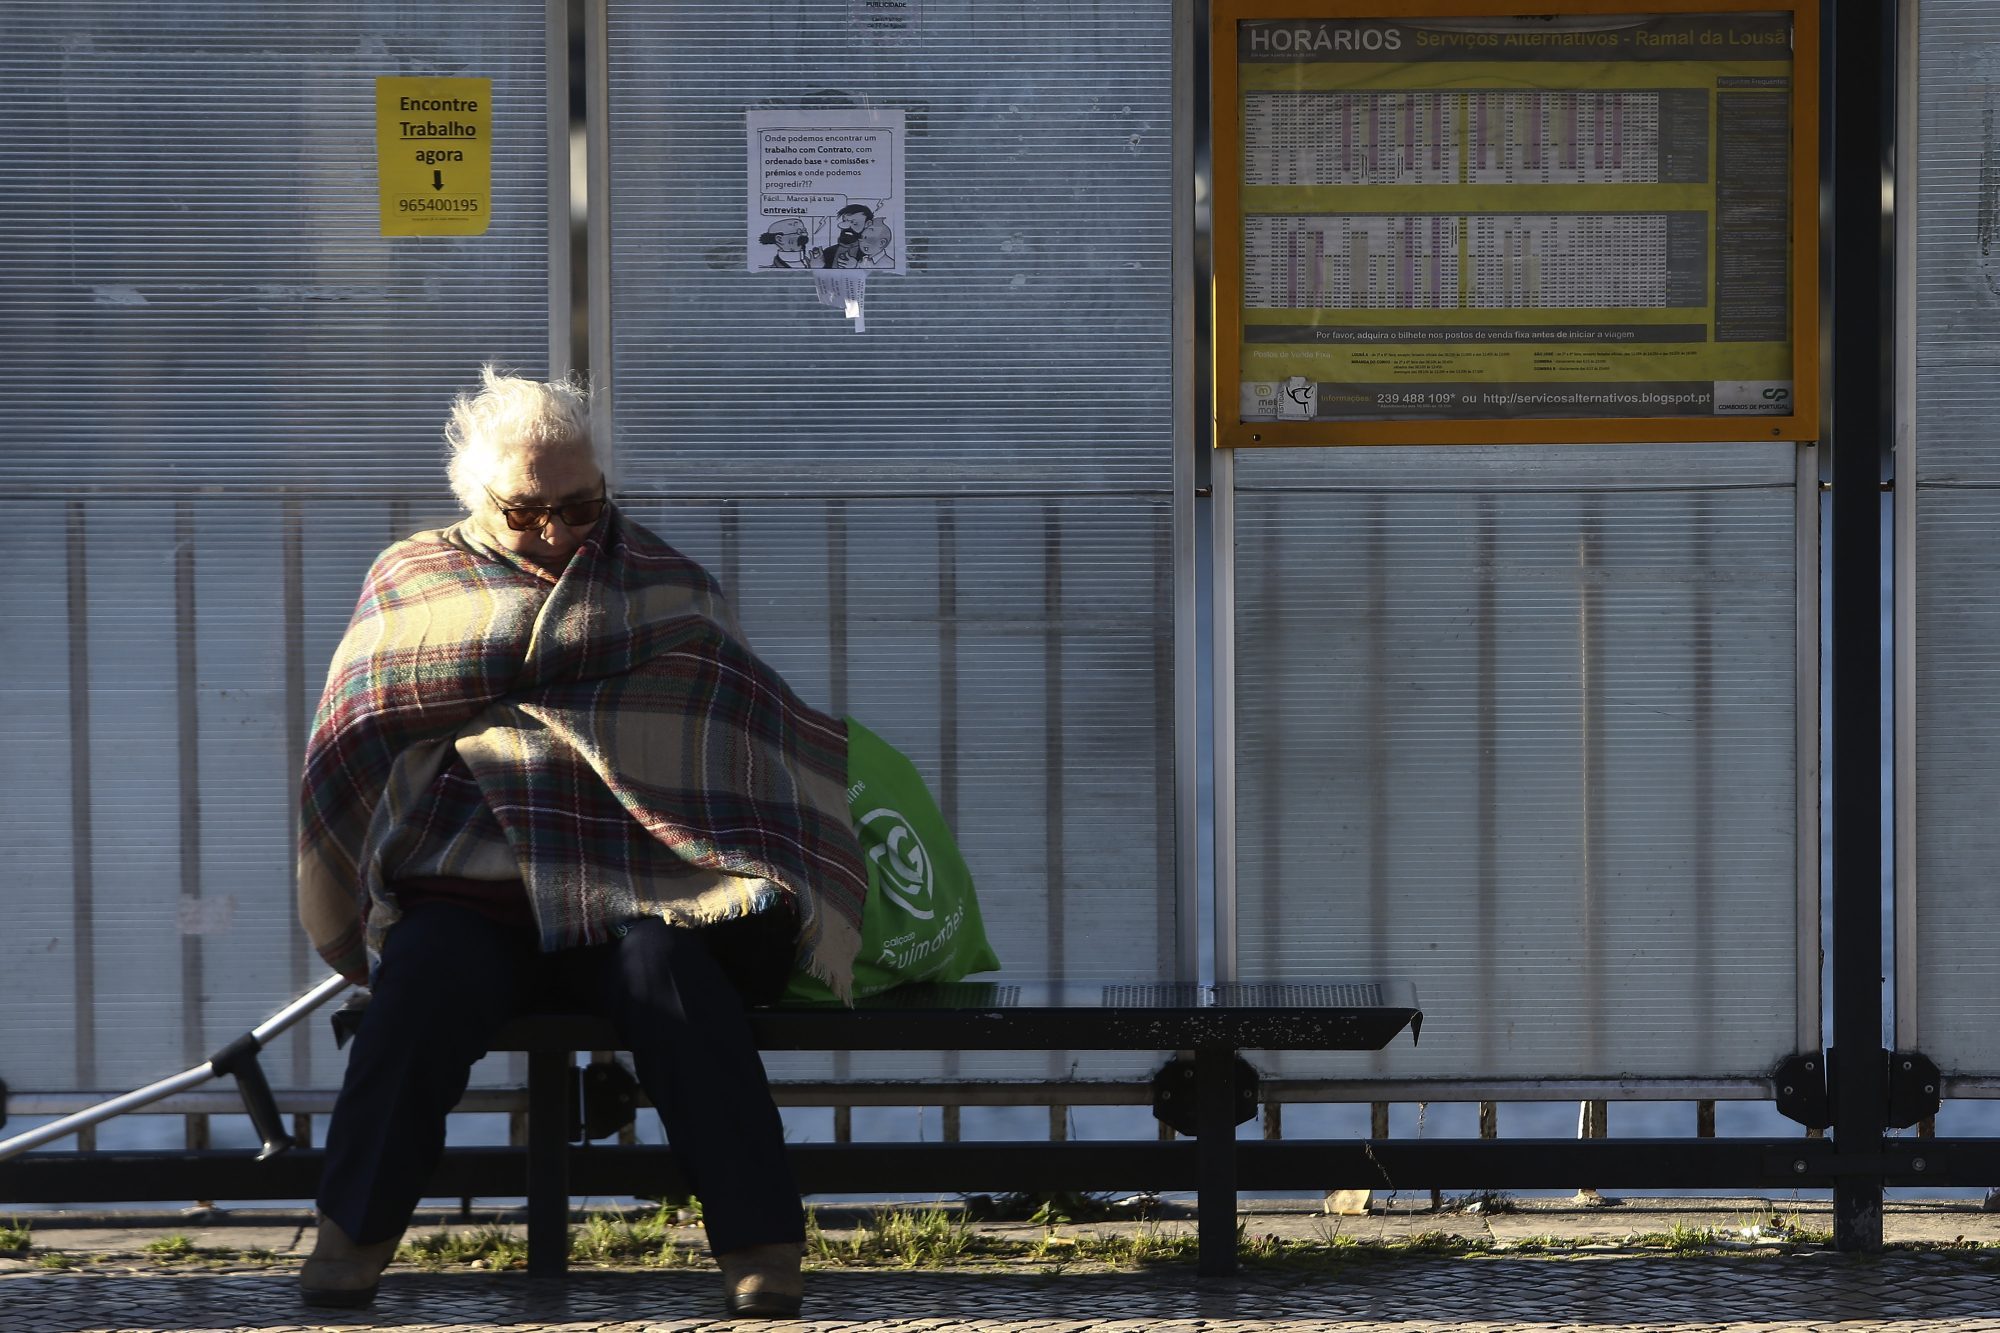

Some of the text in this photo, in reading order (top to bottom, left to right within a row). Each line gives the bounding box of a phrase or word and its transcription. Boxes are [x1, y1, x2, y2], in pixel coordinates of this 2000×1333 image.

[1250, 24, 1402, 51] HORÁRIOS
[1416, 31, 1499, 49] Serviços
[1503, 31, 1619, 47] Alternativos
[1635, 29, 1694, 47] Ramal
[1699, 29, 1723, 46] da
[1728, 29, 1786, 46] Lousã
[400, 96, 478, 112] Encontre
[400, 121, 477, 137] Trabalho
[764, 134, 787, 142] Onde
[788, 134, 824, 144] podemos
[825, 134, 863, 142] encontrar
[764, 146, 798, 154] trabalho
[817, 145, 854, 155] Contrato,
[415, 149, 464, 165] agora
[830, 157, 869, 165] comissões
[764, 169, 797, 178] prémios
[804, 169, 825, 177] onde
[825, 168, 861, 178] podemos
[765, 180, 813, 190] progredir?!?
[786, 195, 809, 203] Marca
[809, 195, 817, 204] já
[823, 195, 835, 203] tua
[399, 199, 478, 212] 965400195
[763, 206, 809, 215] entrevista!
[1316, 329, 1635, 341] Por favor, adquira o bilhete nos postos de venda fixa antes de iniciar a viagem
[1253, 350, 1278, 359] Postos
[1376, 393, 1400, 404] 239
[1402, 393, 1425, 404] 488
[1461, 394, 1477, 404] ou
[1483, 392, 1711, 406] http://servicosalternativos.blogspot.pt
[1718, 403, 1789, 411] COMBOIOS DE PORTUGAL
